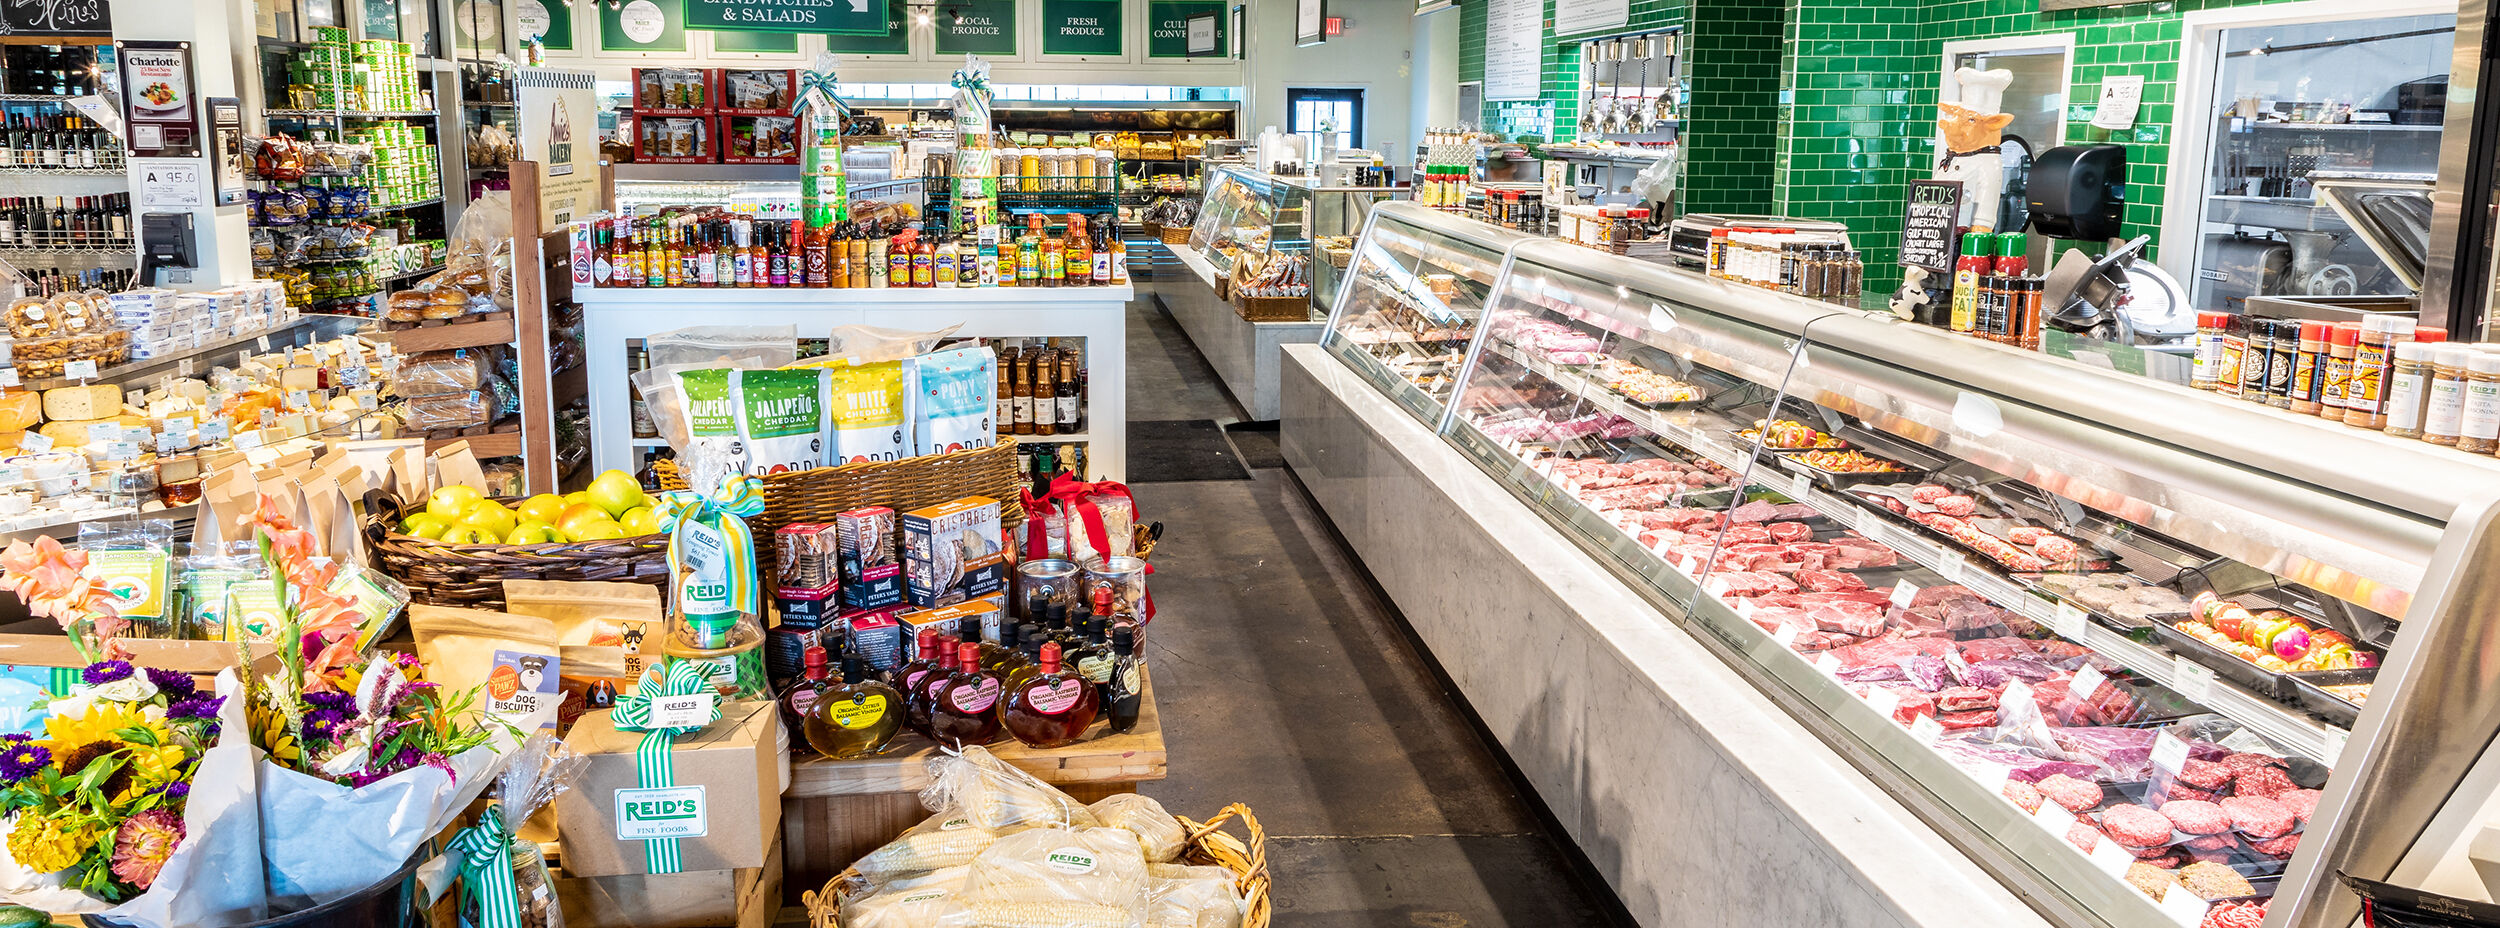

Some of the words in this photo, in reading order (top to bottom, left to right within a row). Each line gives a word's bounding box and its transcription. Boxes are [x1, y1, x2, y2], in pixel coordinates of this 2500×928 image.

[723, 8, 737, 21] &
[742, 8, 817, 23] SALADS
[959, 17, 993, 26] OCAL
[1067, 17, 1098, 26] FRESH
[952, 26, 1000, 35] PRODUCE
[1060, 27, 1105, 36] PRODUCE
[1325, 17, 1341, 34] XIT
[129, 57, 180, 66] Charlotte
[2106, 87, 2114, 98] A
[549, 143, 572, 165] BAKERY
[146, 172, 157, 182] A
[166, 172, 196, 183] 95.0
[1914, 185, 1956, 205] REID'S
[1911, 205, 1951, 218] TROPICAL
[1908, 217, 1949, 228] AMERICAN
[1906, 228, 1922, 239] GULF
[1922, 228, 1940, 240] WILD
[1926, 240, 1945, 248] LARGE
[1955, 286, 1976, 297] DUCK
[1953, 297, 1975, 312] FAT
[941, 379, 975, 399] POPPY
[2470, 385, 2497, 395] REID'S
[846, 390, 888, 410] WHITE
[691, 397, 733, 417] JALAPEÑO
[755, 394, 813, 419] JALAPEÑO
[845, 407, 892, 419] CHEDDAR
[764, 415, 808, 426] CHEDDAR
[932, 503, 1000, 535] CRISPBREAD
[692, 529, 721, 550] REID'S
[686, 584, 726, 601] REID
[886, 590, 900, 598] YARD
[490, 673, 516, 687] SOUTHERN
[494, 680, 516, 696] PAWZ
[1030, 691, 1054, 700] ORGANIC
[1055, 685, 1079, 696] RASPBERRY
[515, 694, 536, 704] DOG
[794, 696, 818, 704] ORGANI
[954, 691, 976, 700] ORGANIC
[956, 696, 979, 705] BALSAMIC
[1033, 696, 1057, 705] BALSAMIC
[1057, 691, 1079, 701] VINEGAR
[494, 701, 536, 713] BISCUITS
[664, 701, 697, 711] REID'S
[836, 711, 861, 719] BALSAMIC
[861, 707, 882, 715] VINEGAR
[626, 799, 697, 821] REID'S
[1049, 853, 1092, 867] REID'S
